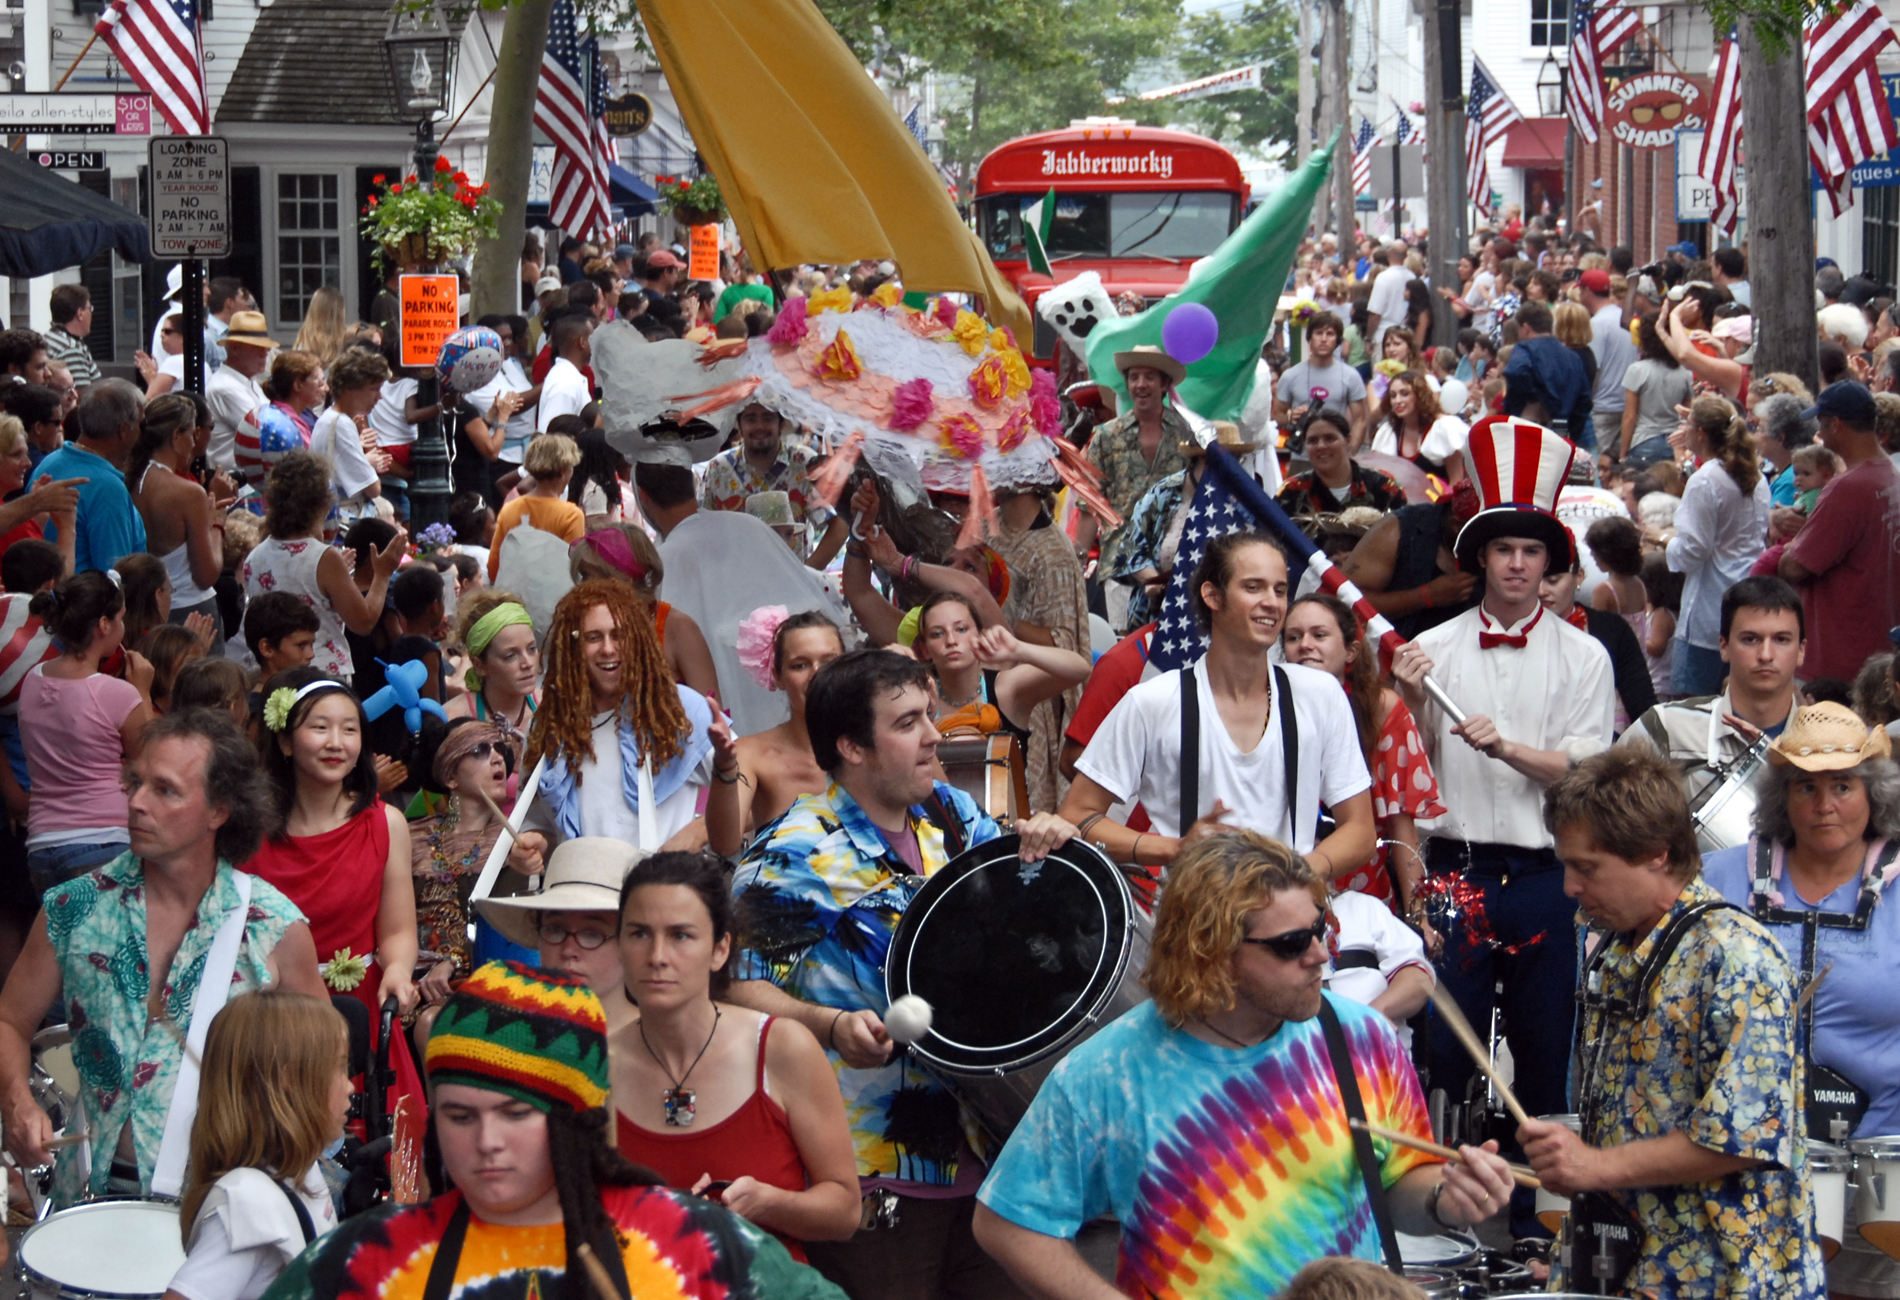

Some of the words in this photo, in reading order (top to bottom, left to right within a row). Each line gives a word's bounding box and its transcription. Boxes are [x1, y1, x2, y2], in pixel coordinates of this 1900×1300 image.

[1607, 75, 1700, 113] SUMMER
[31, 98, 113, 121] allen-styles
[125, 112, 140, 122] OR
[121, 122, 144, 132] LESS
[160, 143, 217, 155] LOADING
[38, 153, 93, 167] OPEN
[172, 157, 207, 168] ZONE
[1041, 149, 1173, 178] Jabberwocky
[156, 170, 162, 180] 8
[167, 170, 183, 180] AM
[198, 170, 204, 180] 6
[208, 170, 223, 180] PM
[1852, 167, 1893, 184] ques
[162, 184, 186, 192] YEAR
[189, 184, 219, 192] ROUND
[180, 196, 199, 208] NO
[162, 209, 219, 220] PARKING
[157, 222, 164, 233] 2
[168, 222, 183, 232] AM
[198, 222, 204, 232] 7
[209, 222, 225, 232] AM
[161, 239, 186, 249] TOW
[192, 239, 223, 249] ZONE
[422, 285, 438, 297] NO
[404, 301, 455, 313] PARKING
[404, 320, 431, 329] PARADE
[433, 320, 455, 328] ROUTE
[413, 332, 424, 341] PM
[426, 332, 436, 341] TO
[413, 346, 428, 354] TOW
[1813, 1089, 1856, 1105] YAMAHA
[1592, 1221, 1629, 1240] YAMAHA
